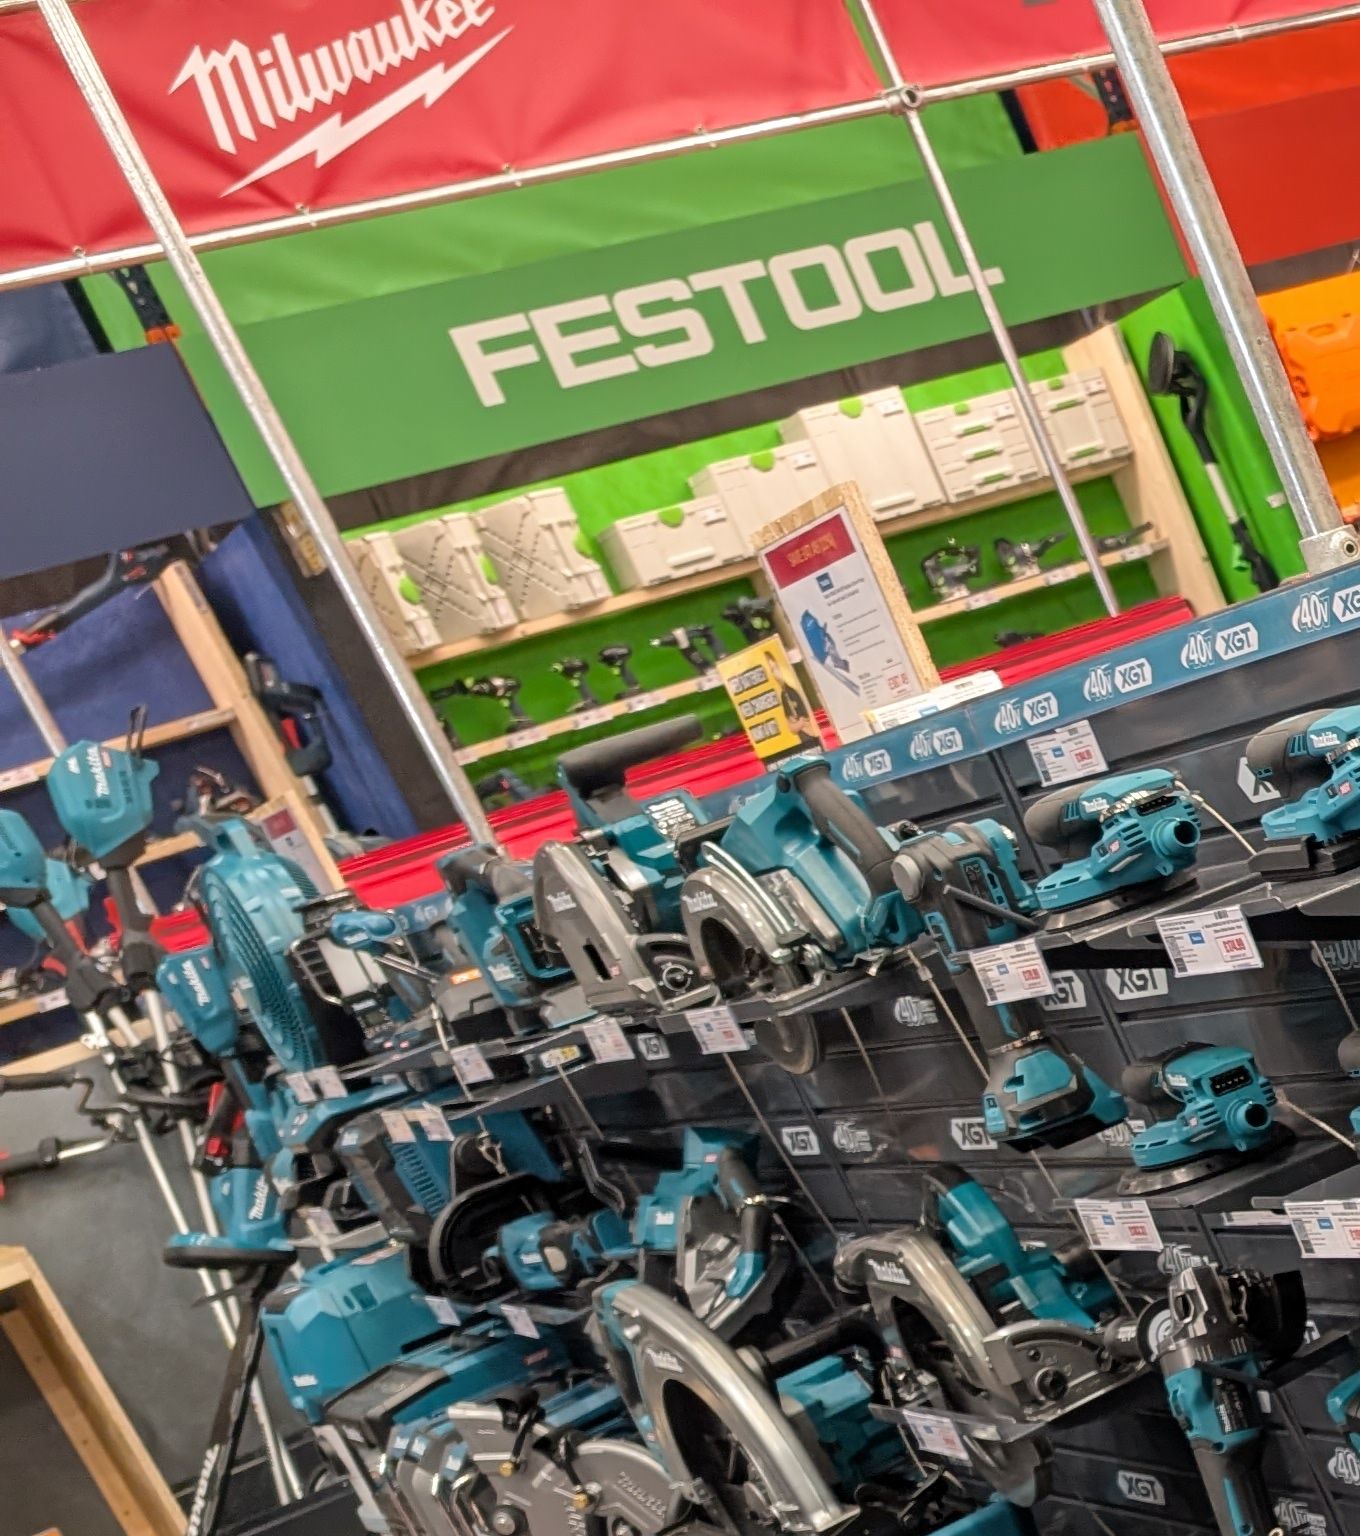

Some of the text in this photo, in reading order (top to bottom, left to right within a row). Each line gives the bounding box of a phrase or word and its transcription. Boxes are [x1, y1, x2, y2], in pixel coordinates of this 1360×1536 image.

[166, 0, 496, 154] Milwaukee
[448, 221, 1005, 407] FESTOOL
[1118, 662, 1146, 689] XGT
[1222, 627, 1251, 655] XGT
